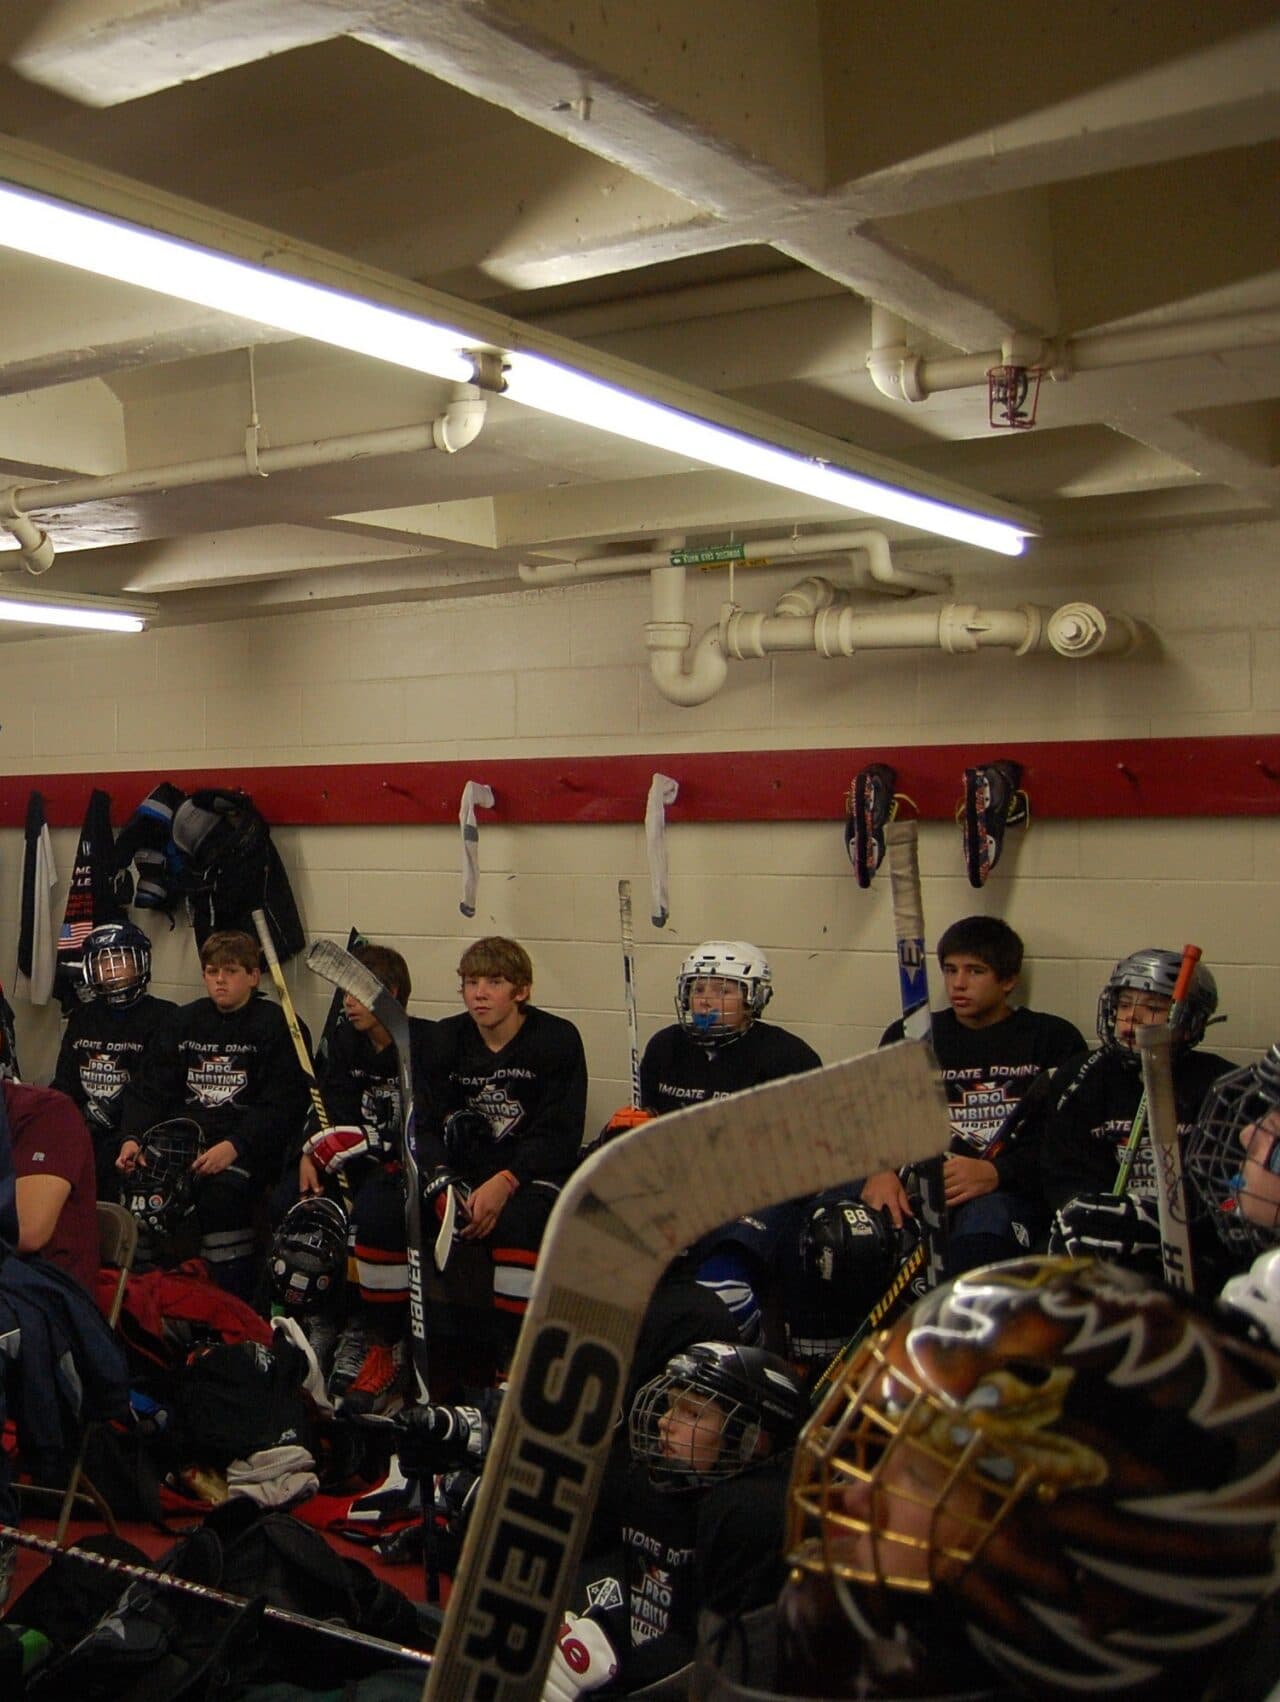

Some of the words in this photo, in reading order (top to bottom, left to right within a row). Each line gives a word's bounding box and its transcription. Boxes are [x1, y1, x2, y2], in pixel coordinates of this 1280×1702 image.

[967, 1092, 1001, 1106] PRO
[843, 1208, 870, 1225] 88
[408, 1246, 425, 1340] BAUER
